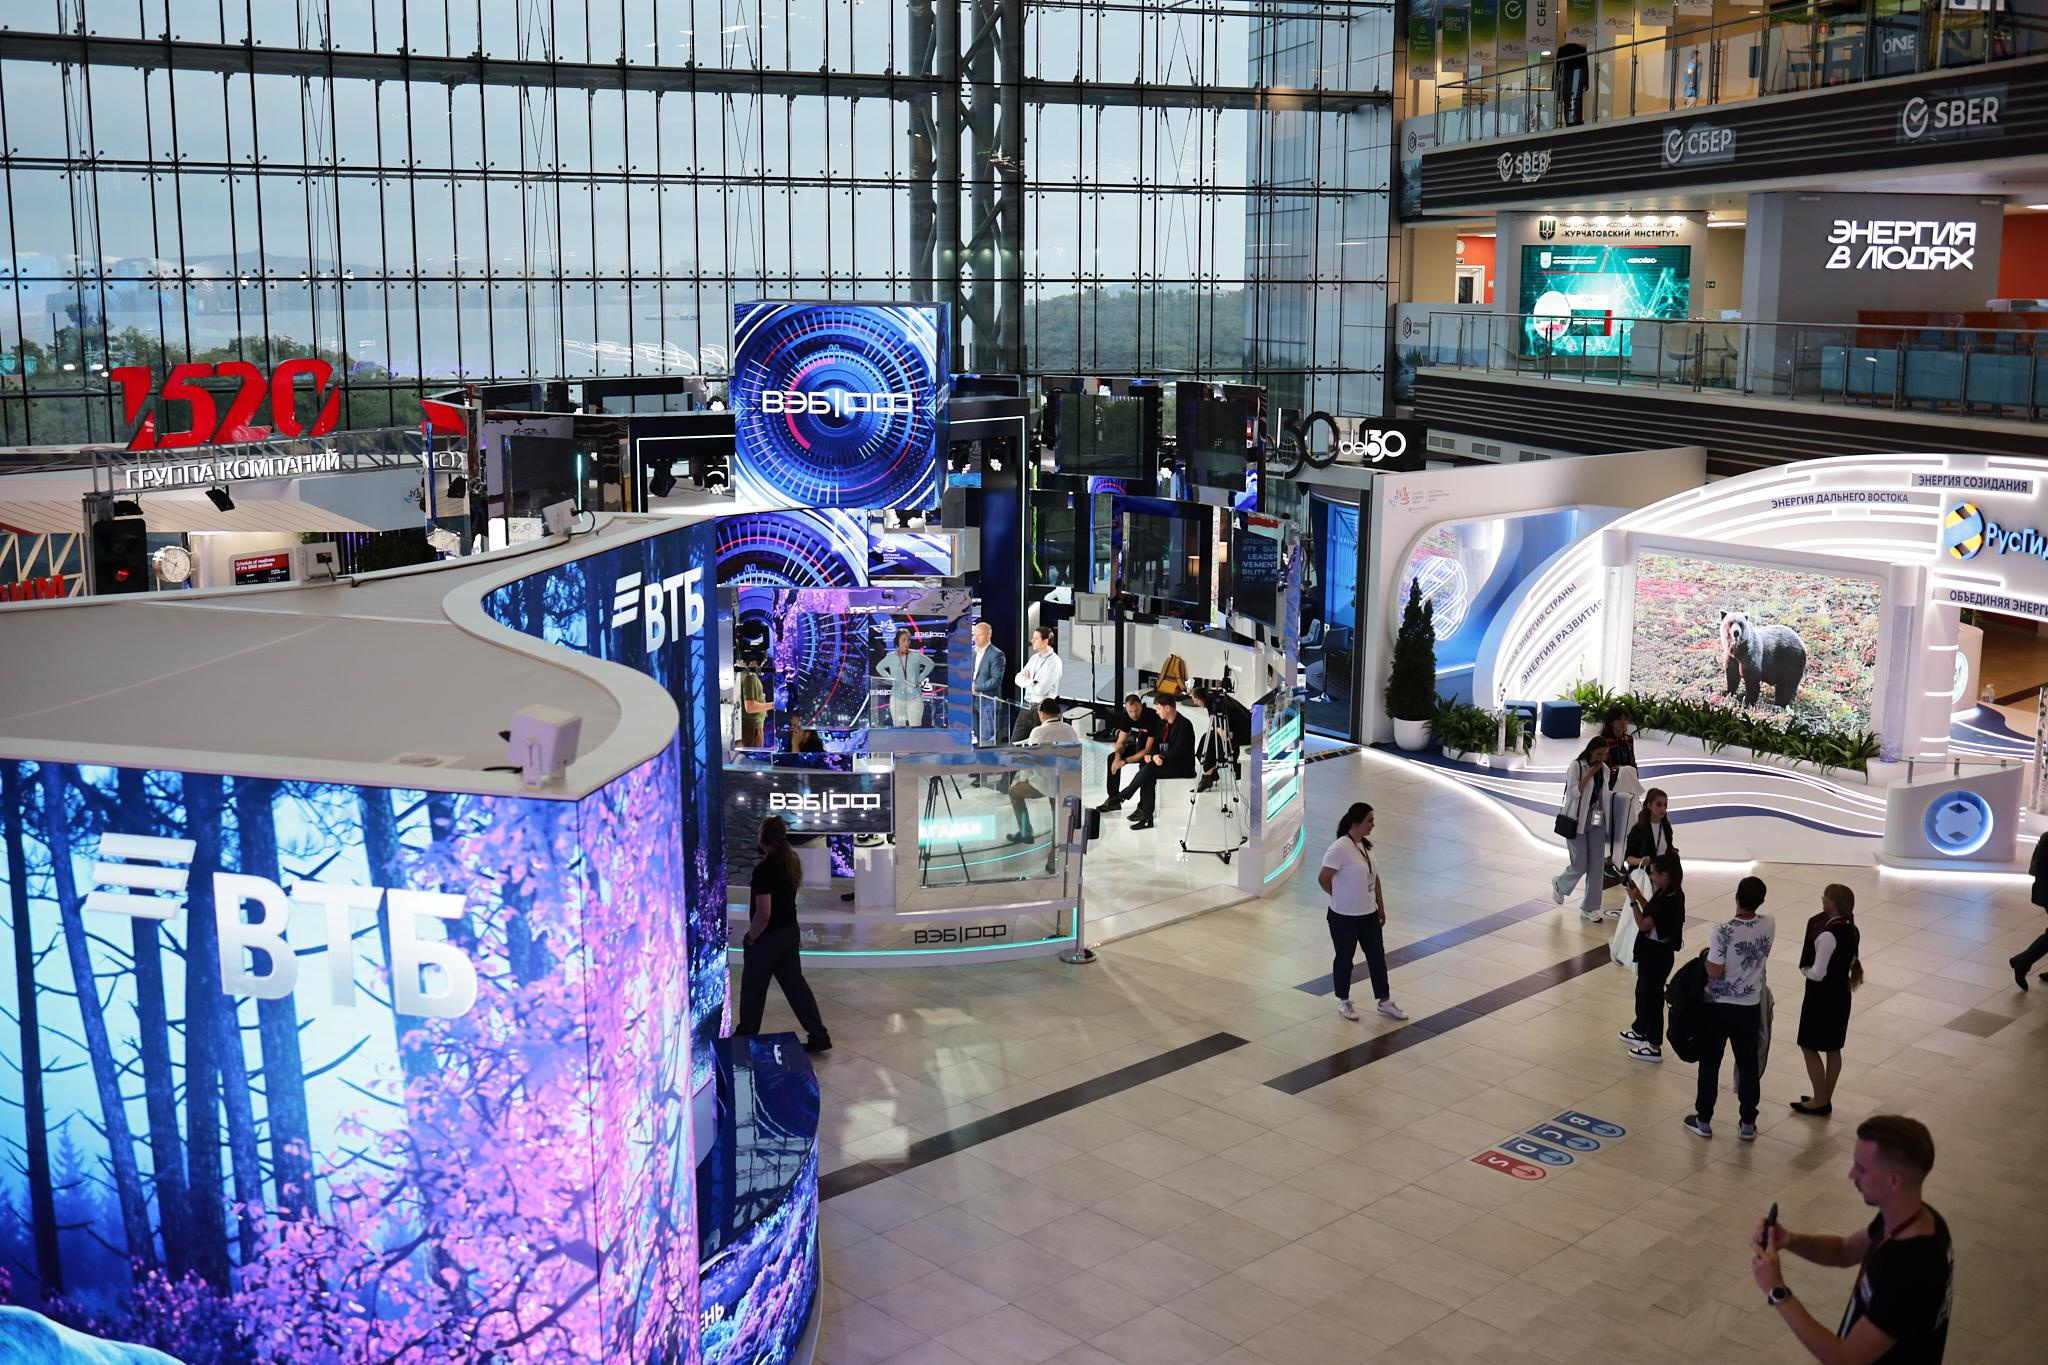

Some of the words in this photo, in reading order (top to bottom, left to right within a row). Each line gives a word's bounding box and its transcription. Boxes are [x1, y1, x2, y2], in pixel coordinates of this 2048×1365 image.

[1882, 34, 1915, 53] ONE
[1934, 96, 1999, 128] SBER
[1688, 129, 1732, 154] СБЕР
[1828, 220, 1977, 246] ЭНЕРГИЯ
[1825, 246, 1851, 269] В
[1856, 245, 1975, 270] ЛЮДЯХ
[111, 359, 340, 450] 1520
[126, 463, 216, 489] ГРУППА
[219, 449, 340, 480] КОМПАНИЙ
[1918, 475, 1961, 486] ЭНЕРГИЯ
[1963, 477, 2028, 492] СОЗИДАНИЯ
[1772, 495, 1814, 508] ЭНЕРГИЯ
[1816, 492, 1866, 503] ДАЛЬНЕГО
[1867, 492, 1909, 503] ВОСТОКА
[644, 566, 705, 653] ВТБ
[1545, 582, 1577, 615] СТРАНЫ
[1949, 590, 2010, 609] ОБЪЕДИНЯЯ
[1522, 640, 1557, 684] ЭНЕРГИЯ
[213, 872, 478, 1019] ВТБ
[1569, 1116, 1590, 1126] B
[1542, 1130, 1562, 1140] C
[1516, 1143, 1538, 1153] D
[1488, 1156, 1508, 1167] S
